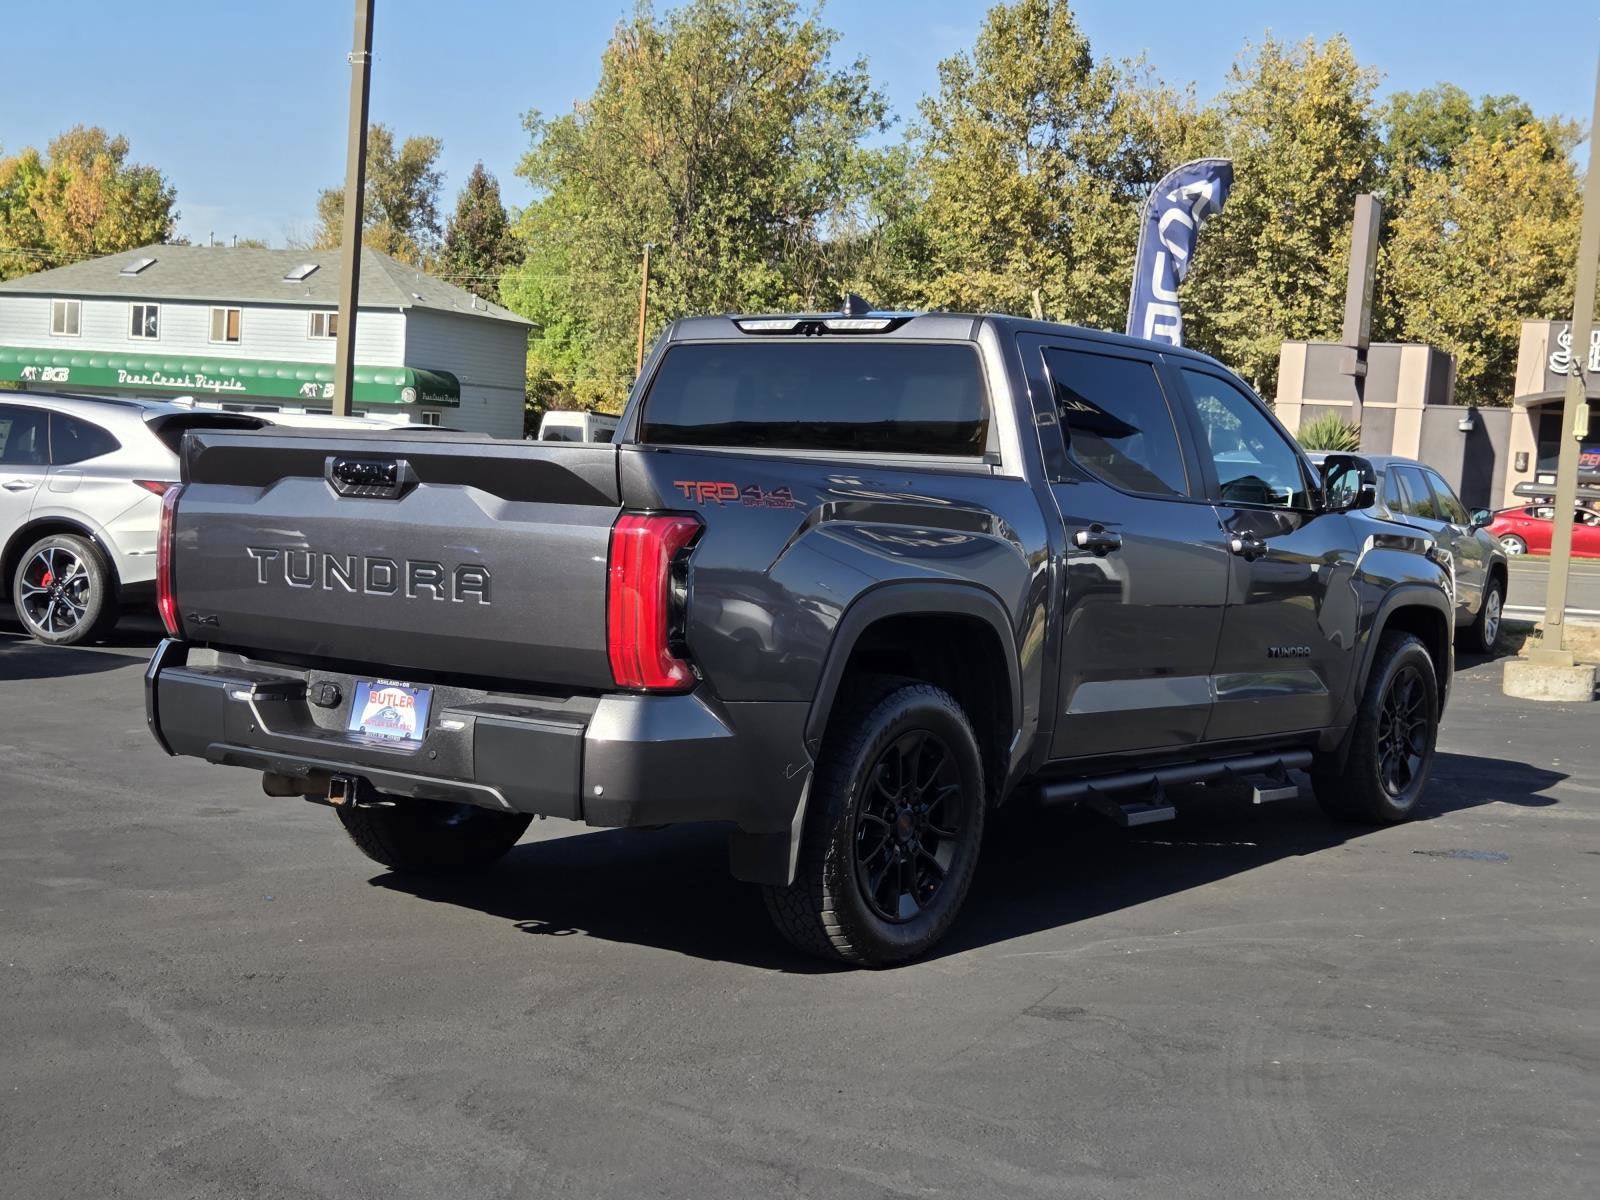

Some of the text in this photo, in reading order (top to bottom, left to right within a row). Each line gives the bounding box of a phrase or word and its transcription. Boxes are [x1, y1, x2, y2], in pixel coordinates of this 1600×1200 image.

[1145, 178, 1221, 347] ACUR
[117, 369, 246, 392] Bear Creek Bicycle
[1578, 453, 1600, 466] PE
[673, 480, 741, 506] TRD
[246, 546, 491, 605] TUNDRA
[1267, 646, 1311, 658] TUNDRA
[376, 679, 400, 687] ASHLAND
[369, 690, 415, 708] BUTLER
